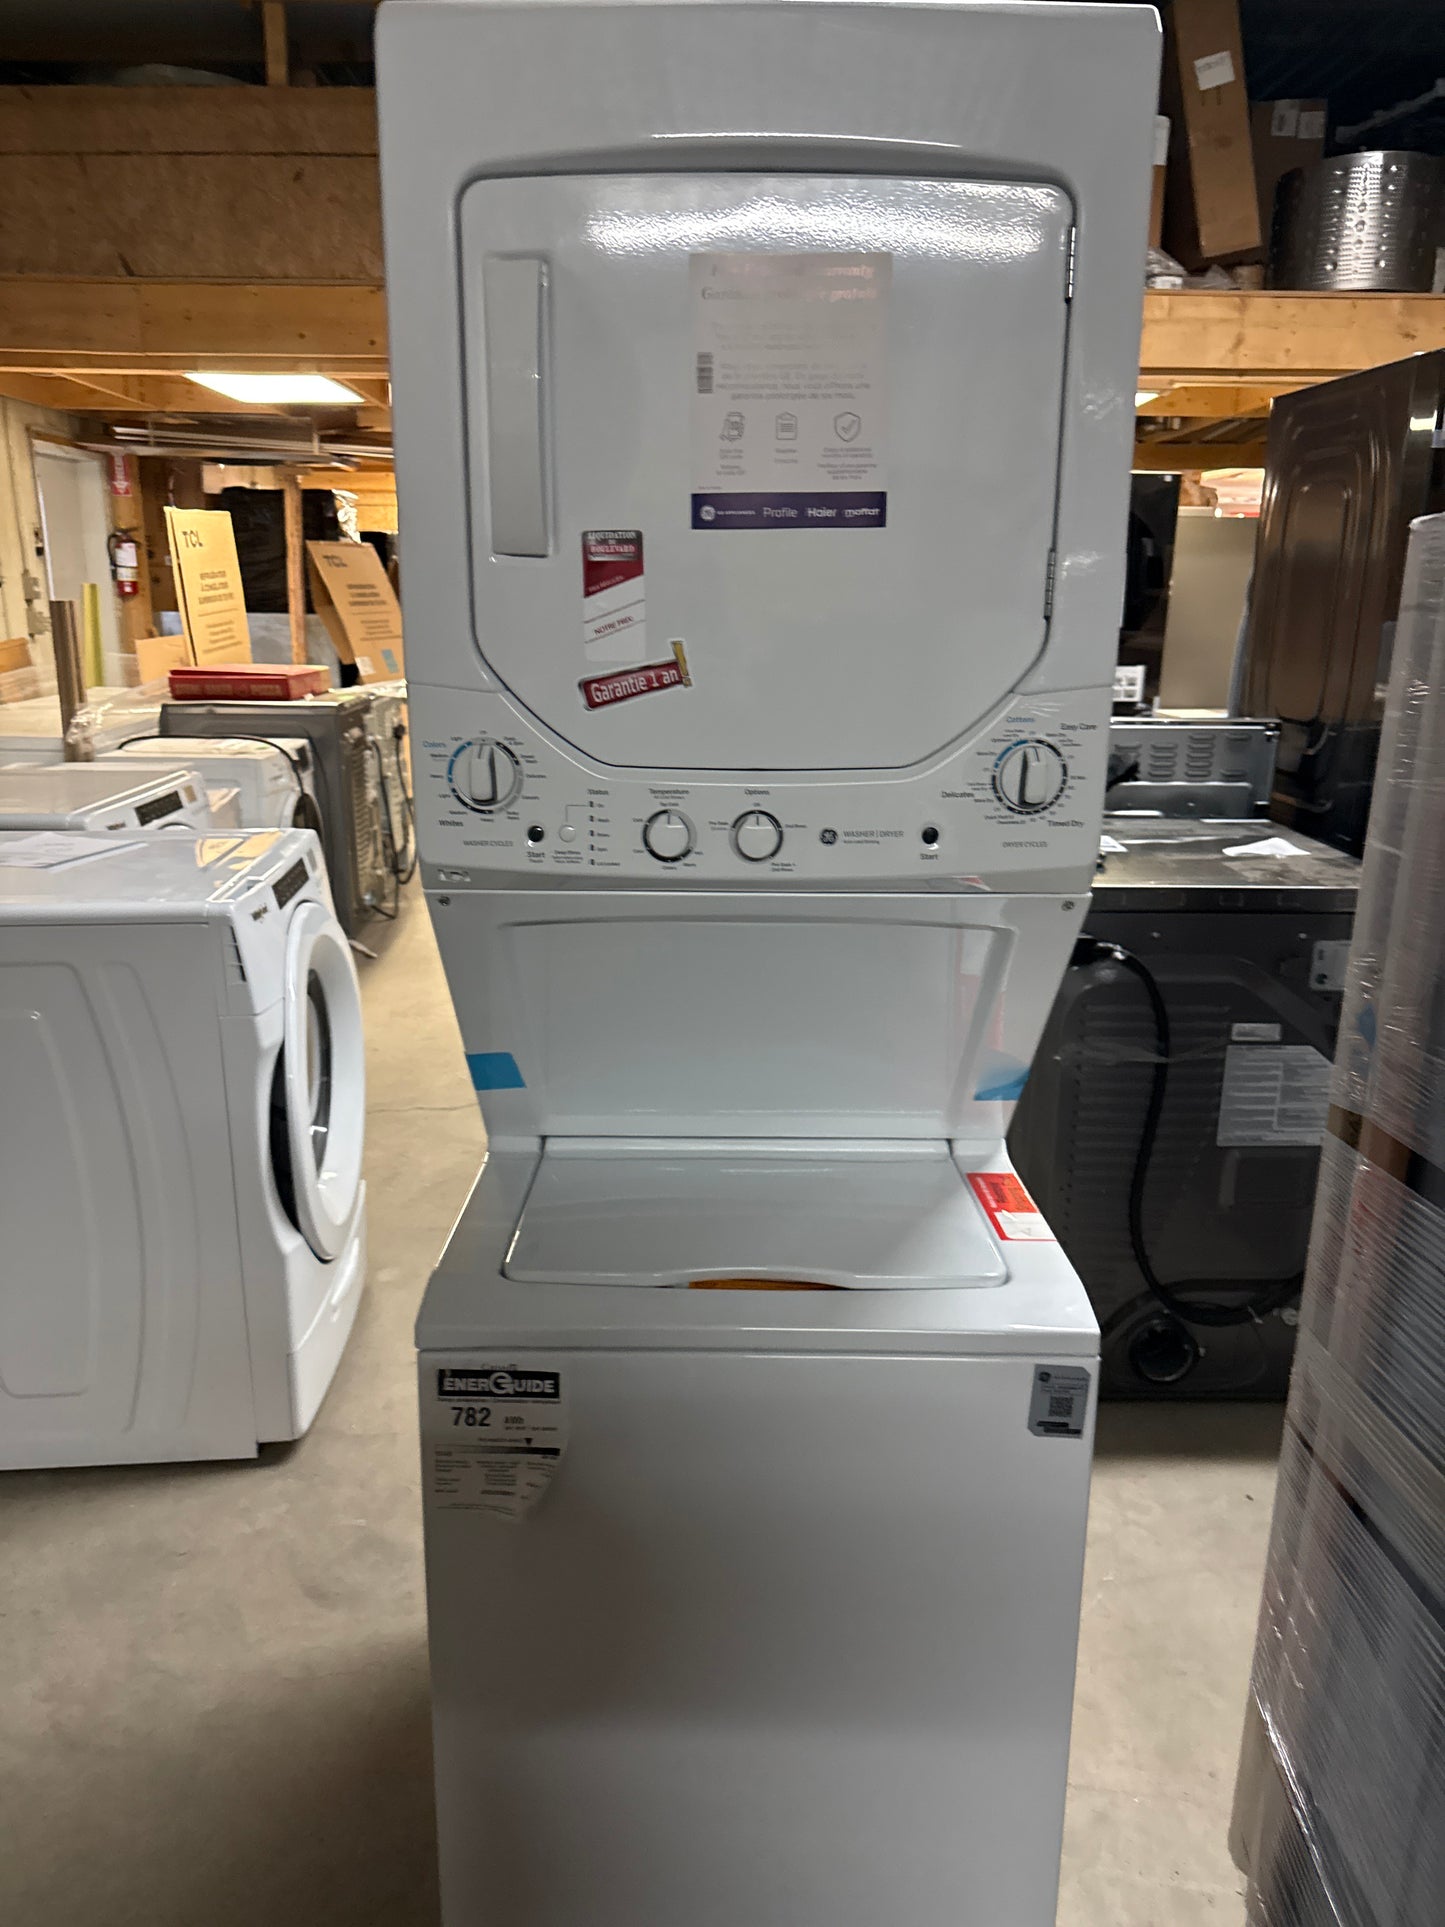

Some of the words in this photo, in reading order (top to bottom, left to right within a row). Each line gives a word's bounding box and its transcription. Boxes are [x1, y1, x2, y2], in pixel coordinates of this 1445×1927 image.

[763, 507, 798, 518] Profile
[807, 507, 837, 517] Haier
[845, 507, 880, 518] moffat
[182, 530, 203, 548] TCL
[587, 531, 637, 540] LIQUIDATION
[590, 544, 636, 553] BOULEVARD
[594, 622, 616, 635] NOTRE
[590, 676, 647, 703] Garantie
[648, 672, 660, 687] 1
[662, 668, 679, 684] an
[1060, 723, 1078, 731] Easy
[422, 740, 447, 749] Colors
[588, 788, 609, 796] Status
[648, 788, 690, 796] Temperature
[745, 789, 770, 797] Options
[438, 819, 464, 828] Whites
[1070, 820, 1085, 828] Dry
[843, 830, 875, 838] WASHER
[879, 830, 904, 838] DRYER
[527, 851, 546, 859] Start
[442, 1371, 556, 1395] ENERGUIDE
[451, 1406, 491, 1427] 782
